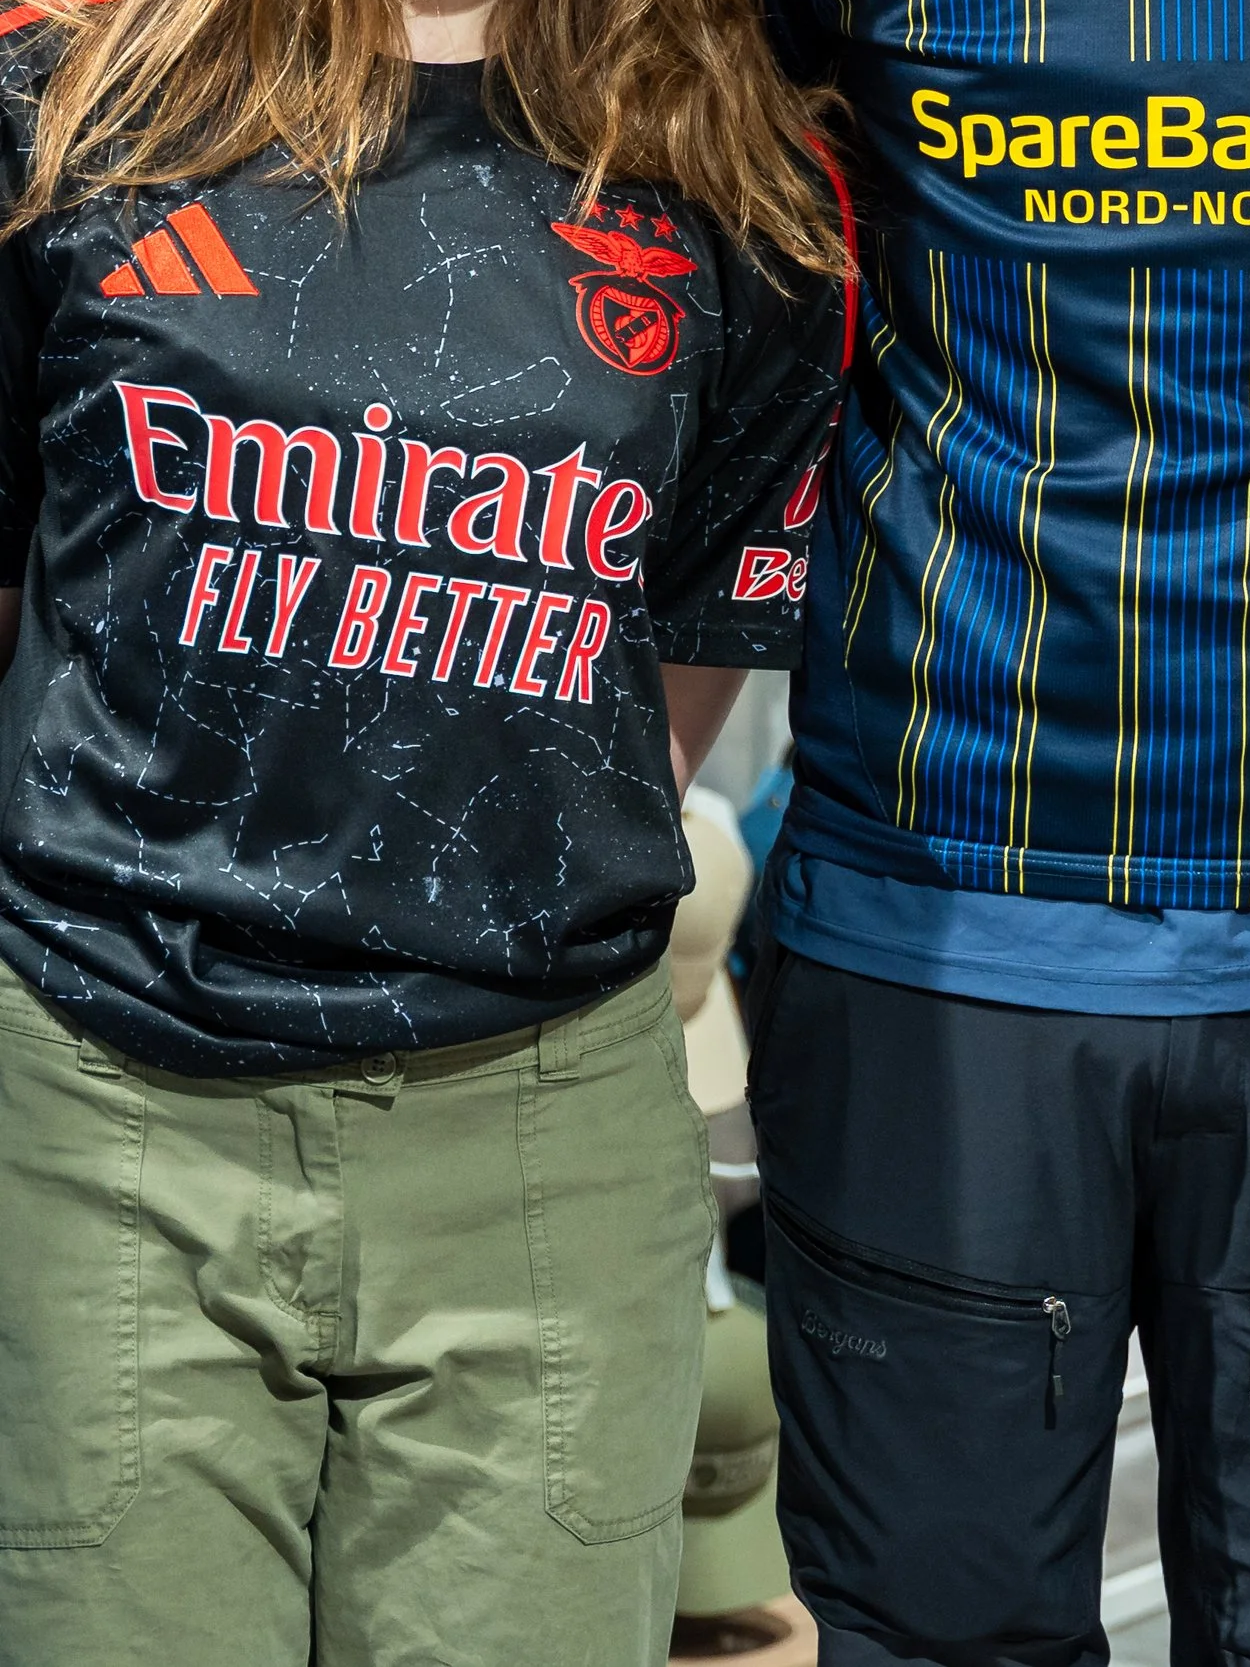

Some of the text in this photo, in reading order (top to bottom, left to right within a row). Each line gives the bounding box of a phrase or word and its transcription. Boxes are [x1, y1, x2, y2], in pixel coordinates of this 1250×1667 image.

[114, 380, 653, 591] Emirate
[179, 543, 611, 704] FLY BETTER
